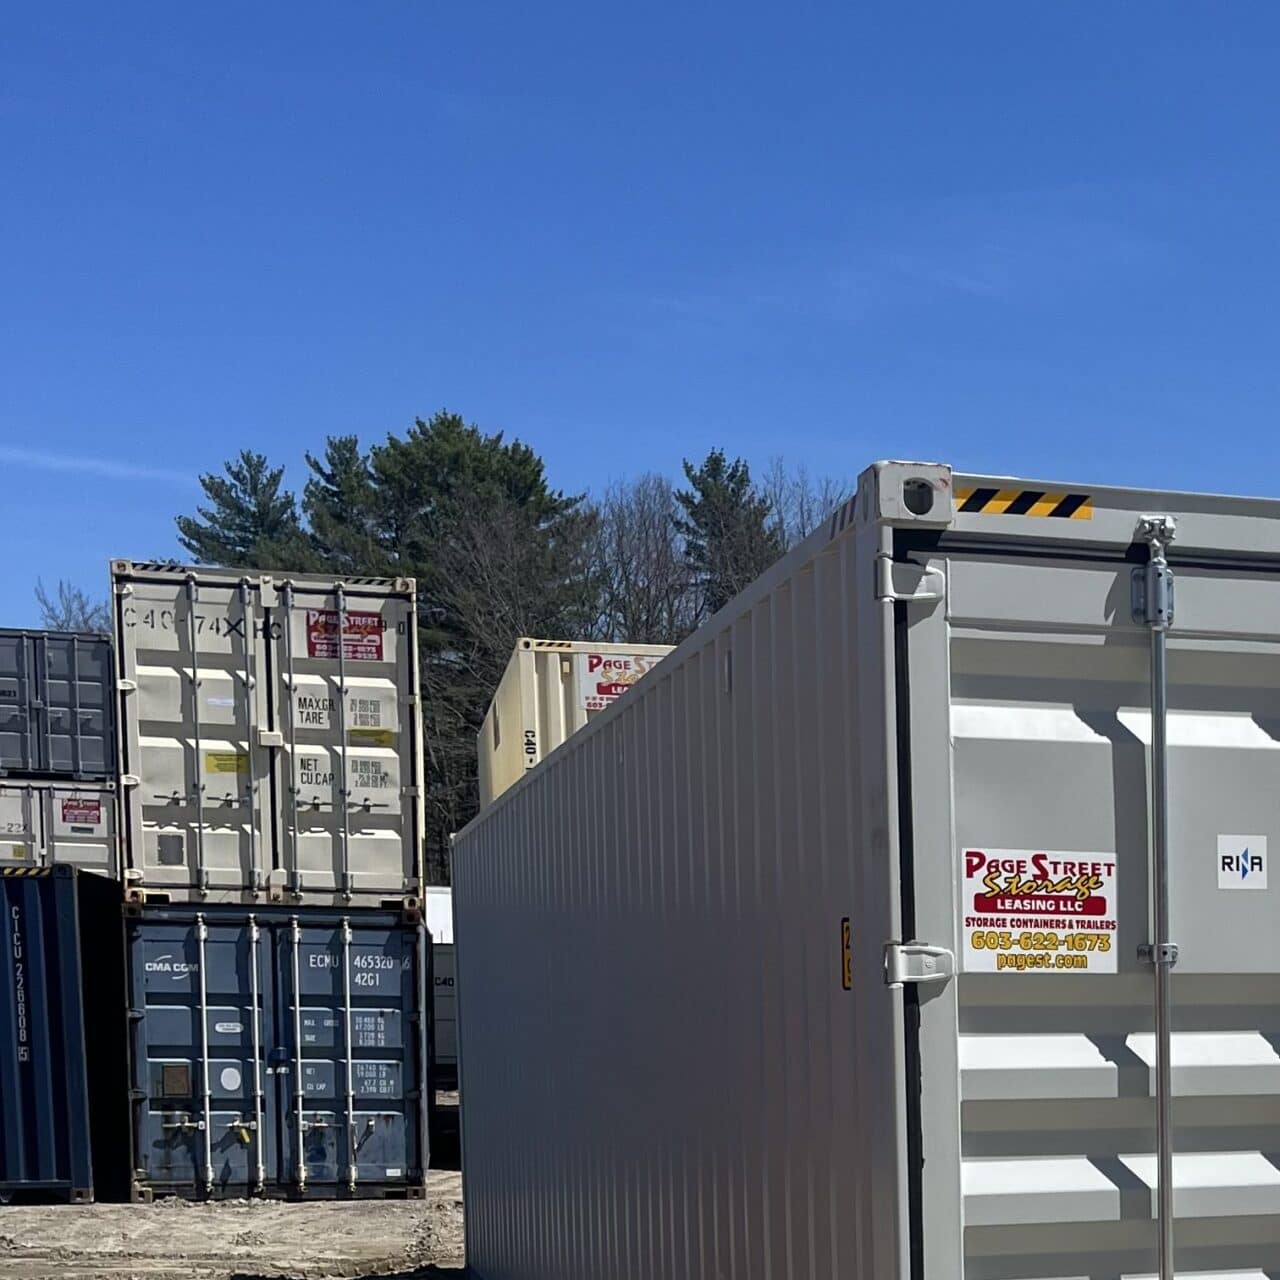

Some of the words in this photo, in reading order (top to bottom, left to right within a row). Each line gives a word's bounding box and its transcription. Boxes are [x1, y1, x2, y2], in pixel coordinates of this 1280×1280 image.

[588, 654, 632, 673] PAGE
[299, 711, 324, 724] TARE
[300, 758, 318, 772] NET
[965, 851, 1027, 878] PAGE
[1031, 854, 1115, 880] STREET
[983, 871, 1104, 900] Storage
[996, 899, 1056, 912] LEASING
[1059, 901, 1084, 912] LLC
[965, 917, 1008, 928] STORAGE
[1010, 918, 1067, 929] CONTAINERS
[1068, 920, 1074, 929] &
[1075, 920, 1117, 931] TRAILERS
[971, 931, 1111, 951] 603-622-1673
[145, 963, 171, 972] CMA
[173, 963, 199, 972] CGM
[310, 954, 339, 968] ECMU
[354, 955, 393, 969] 465320
[996, 953, 1088, 970] pagest.com
[355, 973, 379, 986] 42G1
